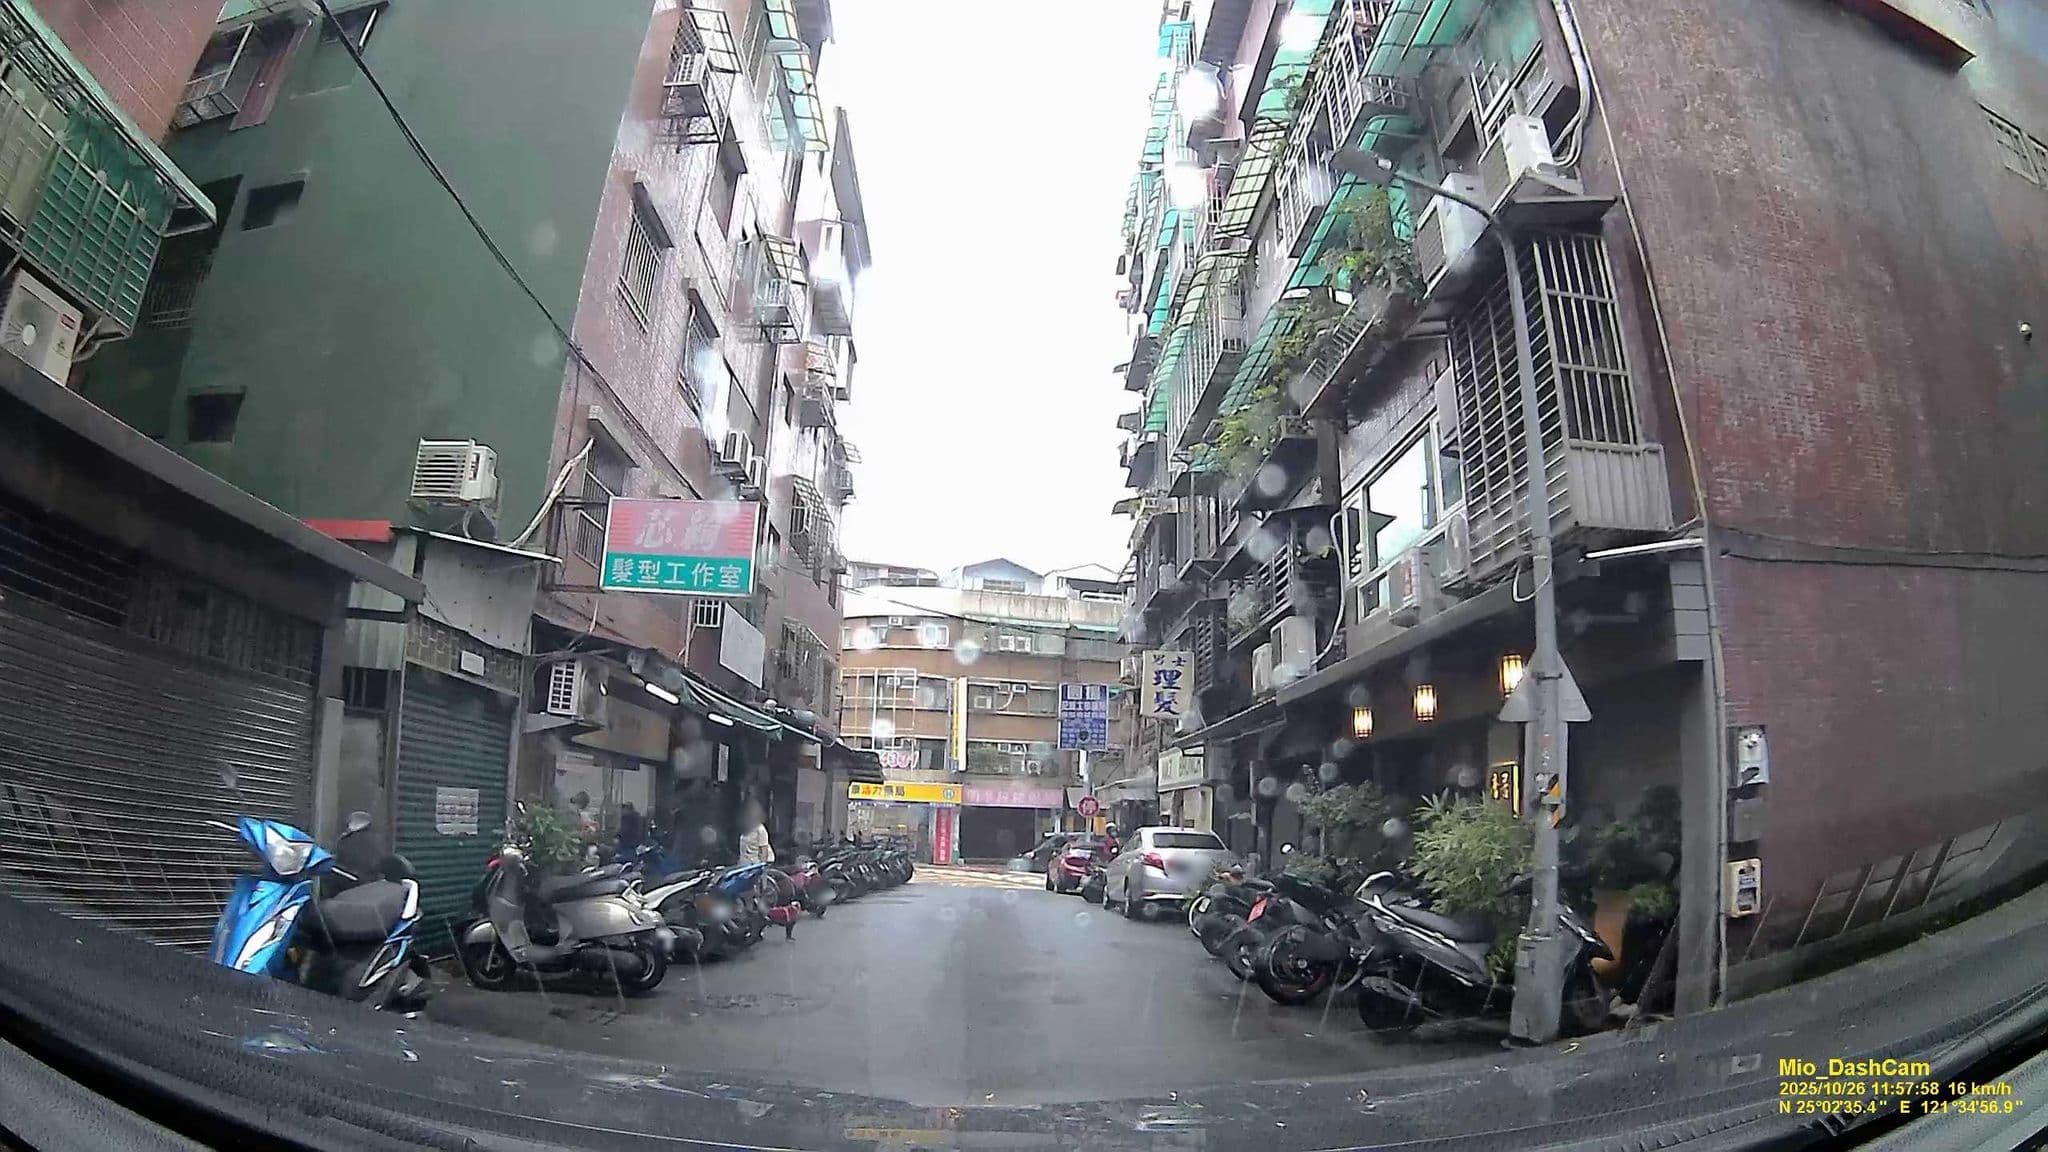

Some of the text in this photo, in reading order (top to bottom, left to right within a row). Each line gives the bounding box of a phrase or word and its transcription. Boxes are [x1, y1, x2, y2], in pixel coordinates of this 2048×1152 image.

[612, 558, 742, 588] 髮型工作室
[1152, 654, 1187, 667] 男士
[1152, 669, 1183, 715] 理髮
